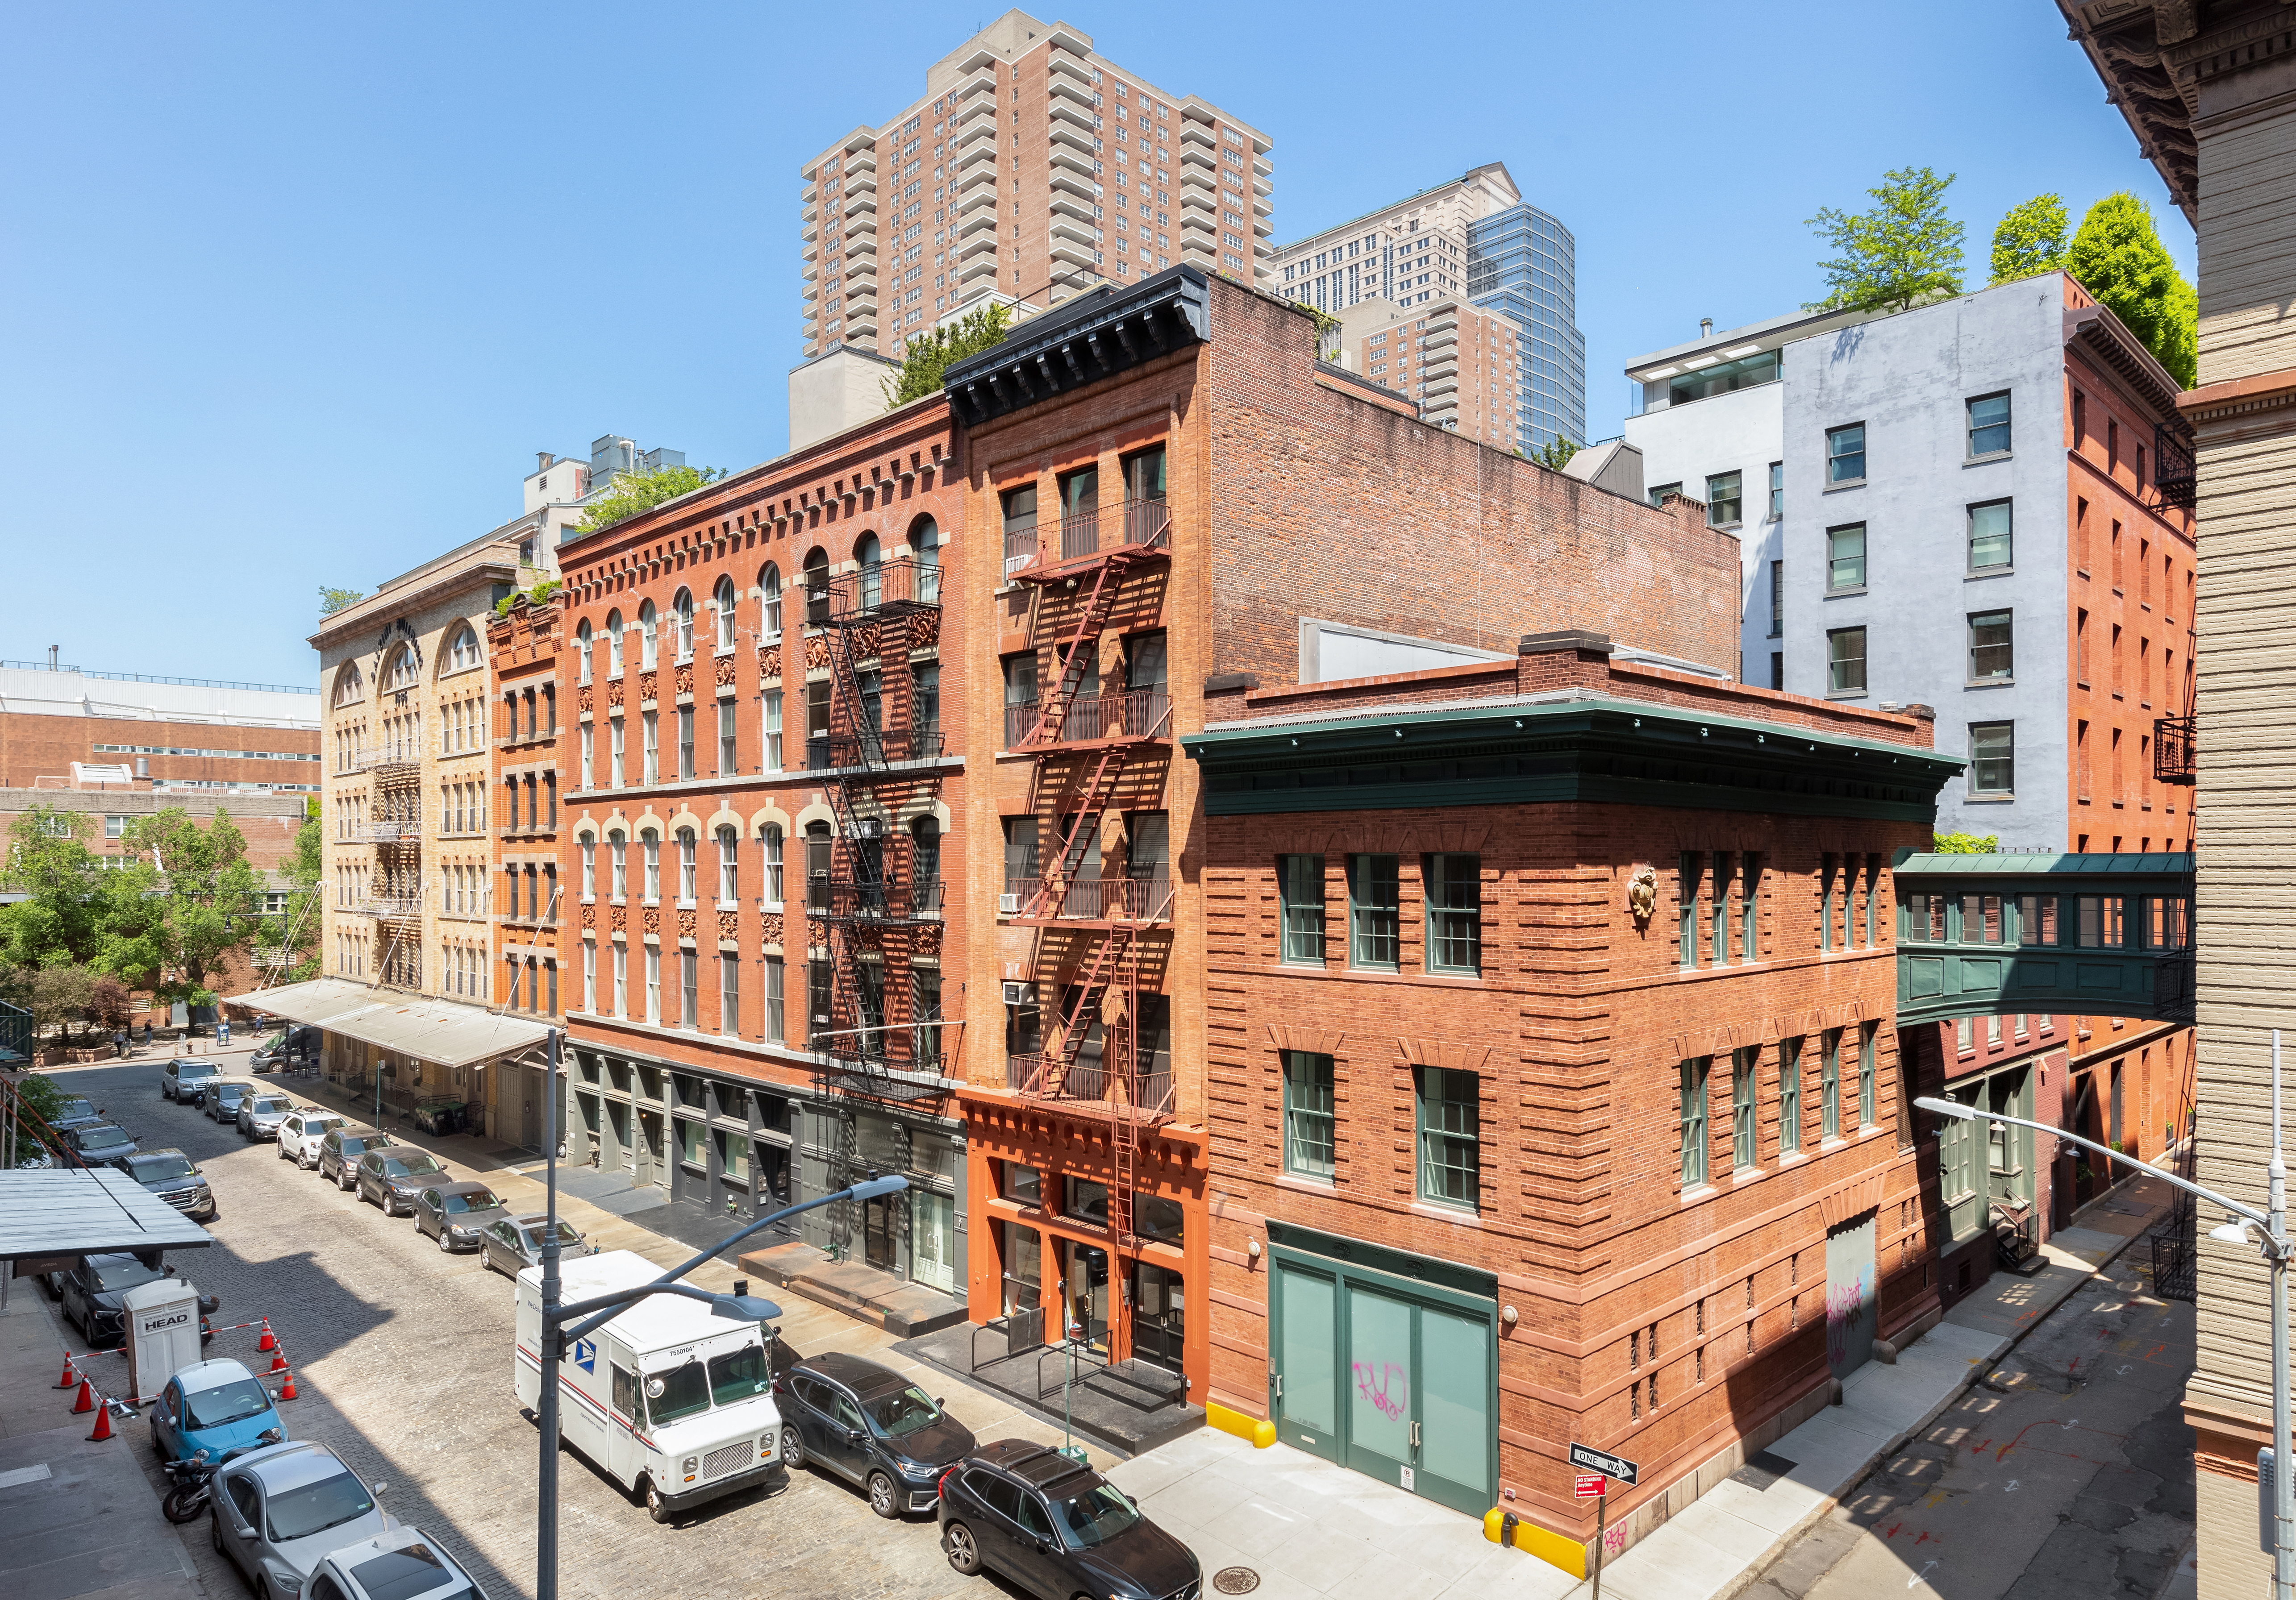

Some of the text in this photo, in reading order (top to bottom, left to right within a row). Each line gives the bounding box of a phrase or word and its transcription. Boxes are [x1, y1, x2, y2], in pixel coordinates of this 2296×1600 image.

[528, 1300, 542, 1314] We Delive
[145, 1314, 188, 1330] HEAD
[670, 1346, 692, 1356] 7550104
[588, 1417, 596, 1427] Electric
[596, 1423, 604, 1433] Vehicle
[1579, 1452, 1598, 1465] ONE
[1607, 1461, 1627, 1475] WAY
